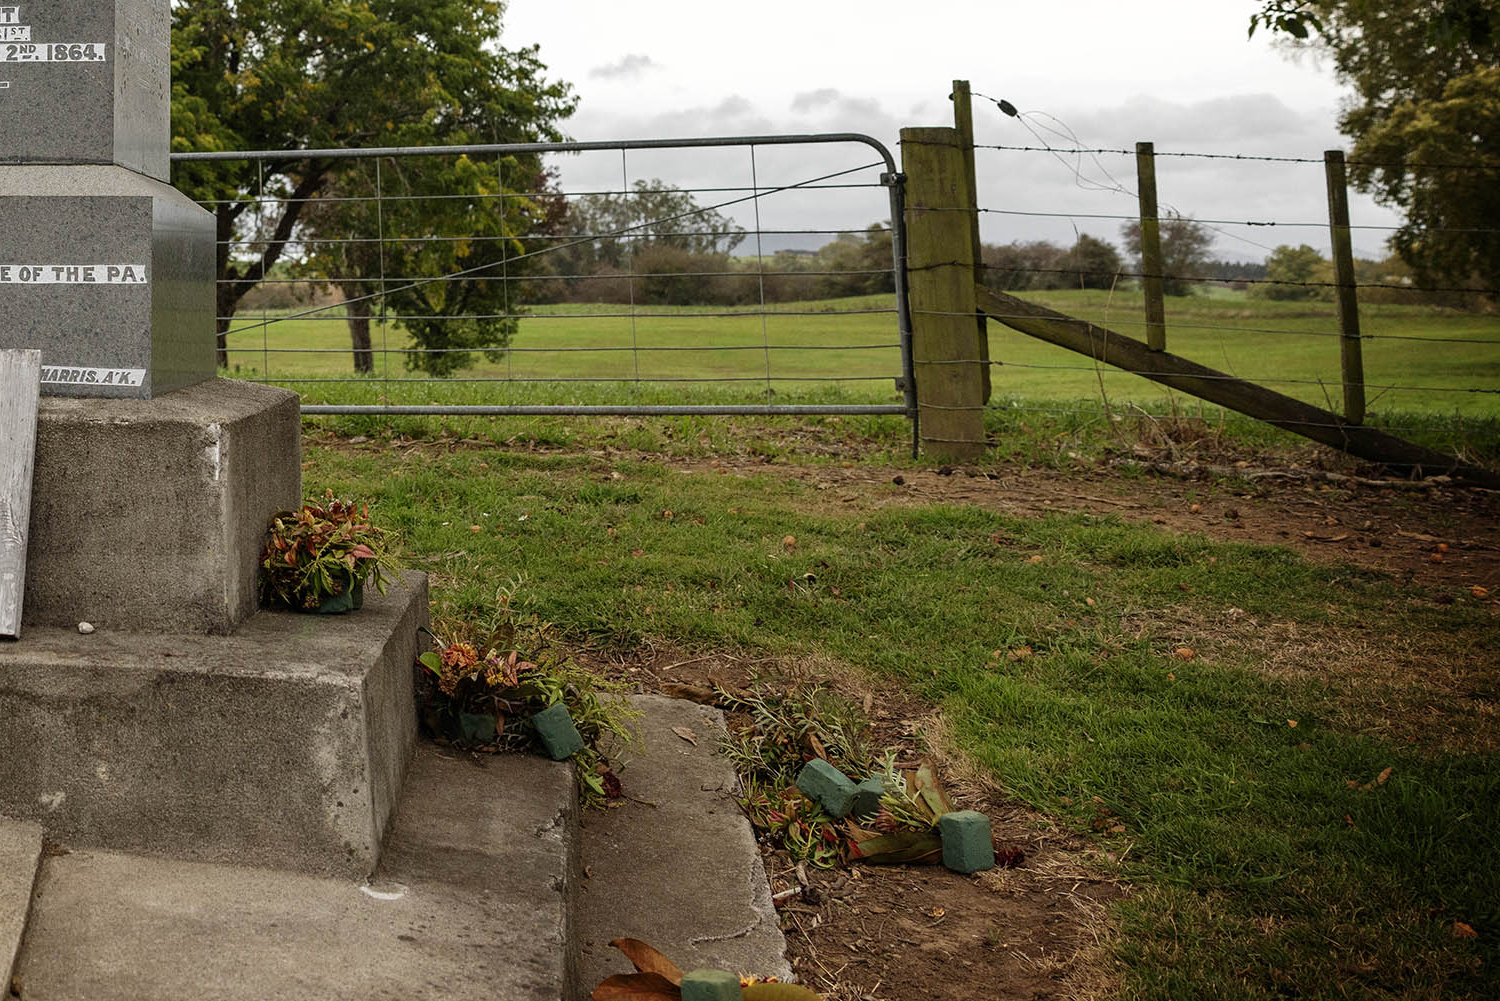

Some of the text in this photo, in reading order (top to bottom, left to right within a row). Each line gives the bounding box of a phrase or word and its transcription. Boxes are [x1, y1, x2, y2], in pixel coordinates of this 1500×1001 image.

[47, 44, 103, 61] 1864.
[19, 267, 43, 282] OF
[51, 266, 95, 282] THE
[107, 266, 145, 282] PA.
